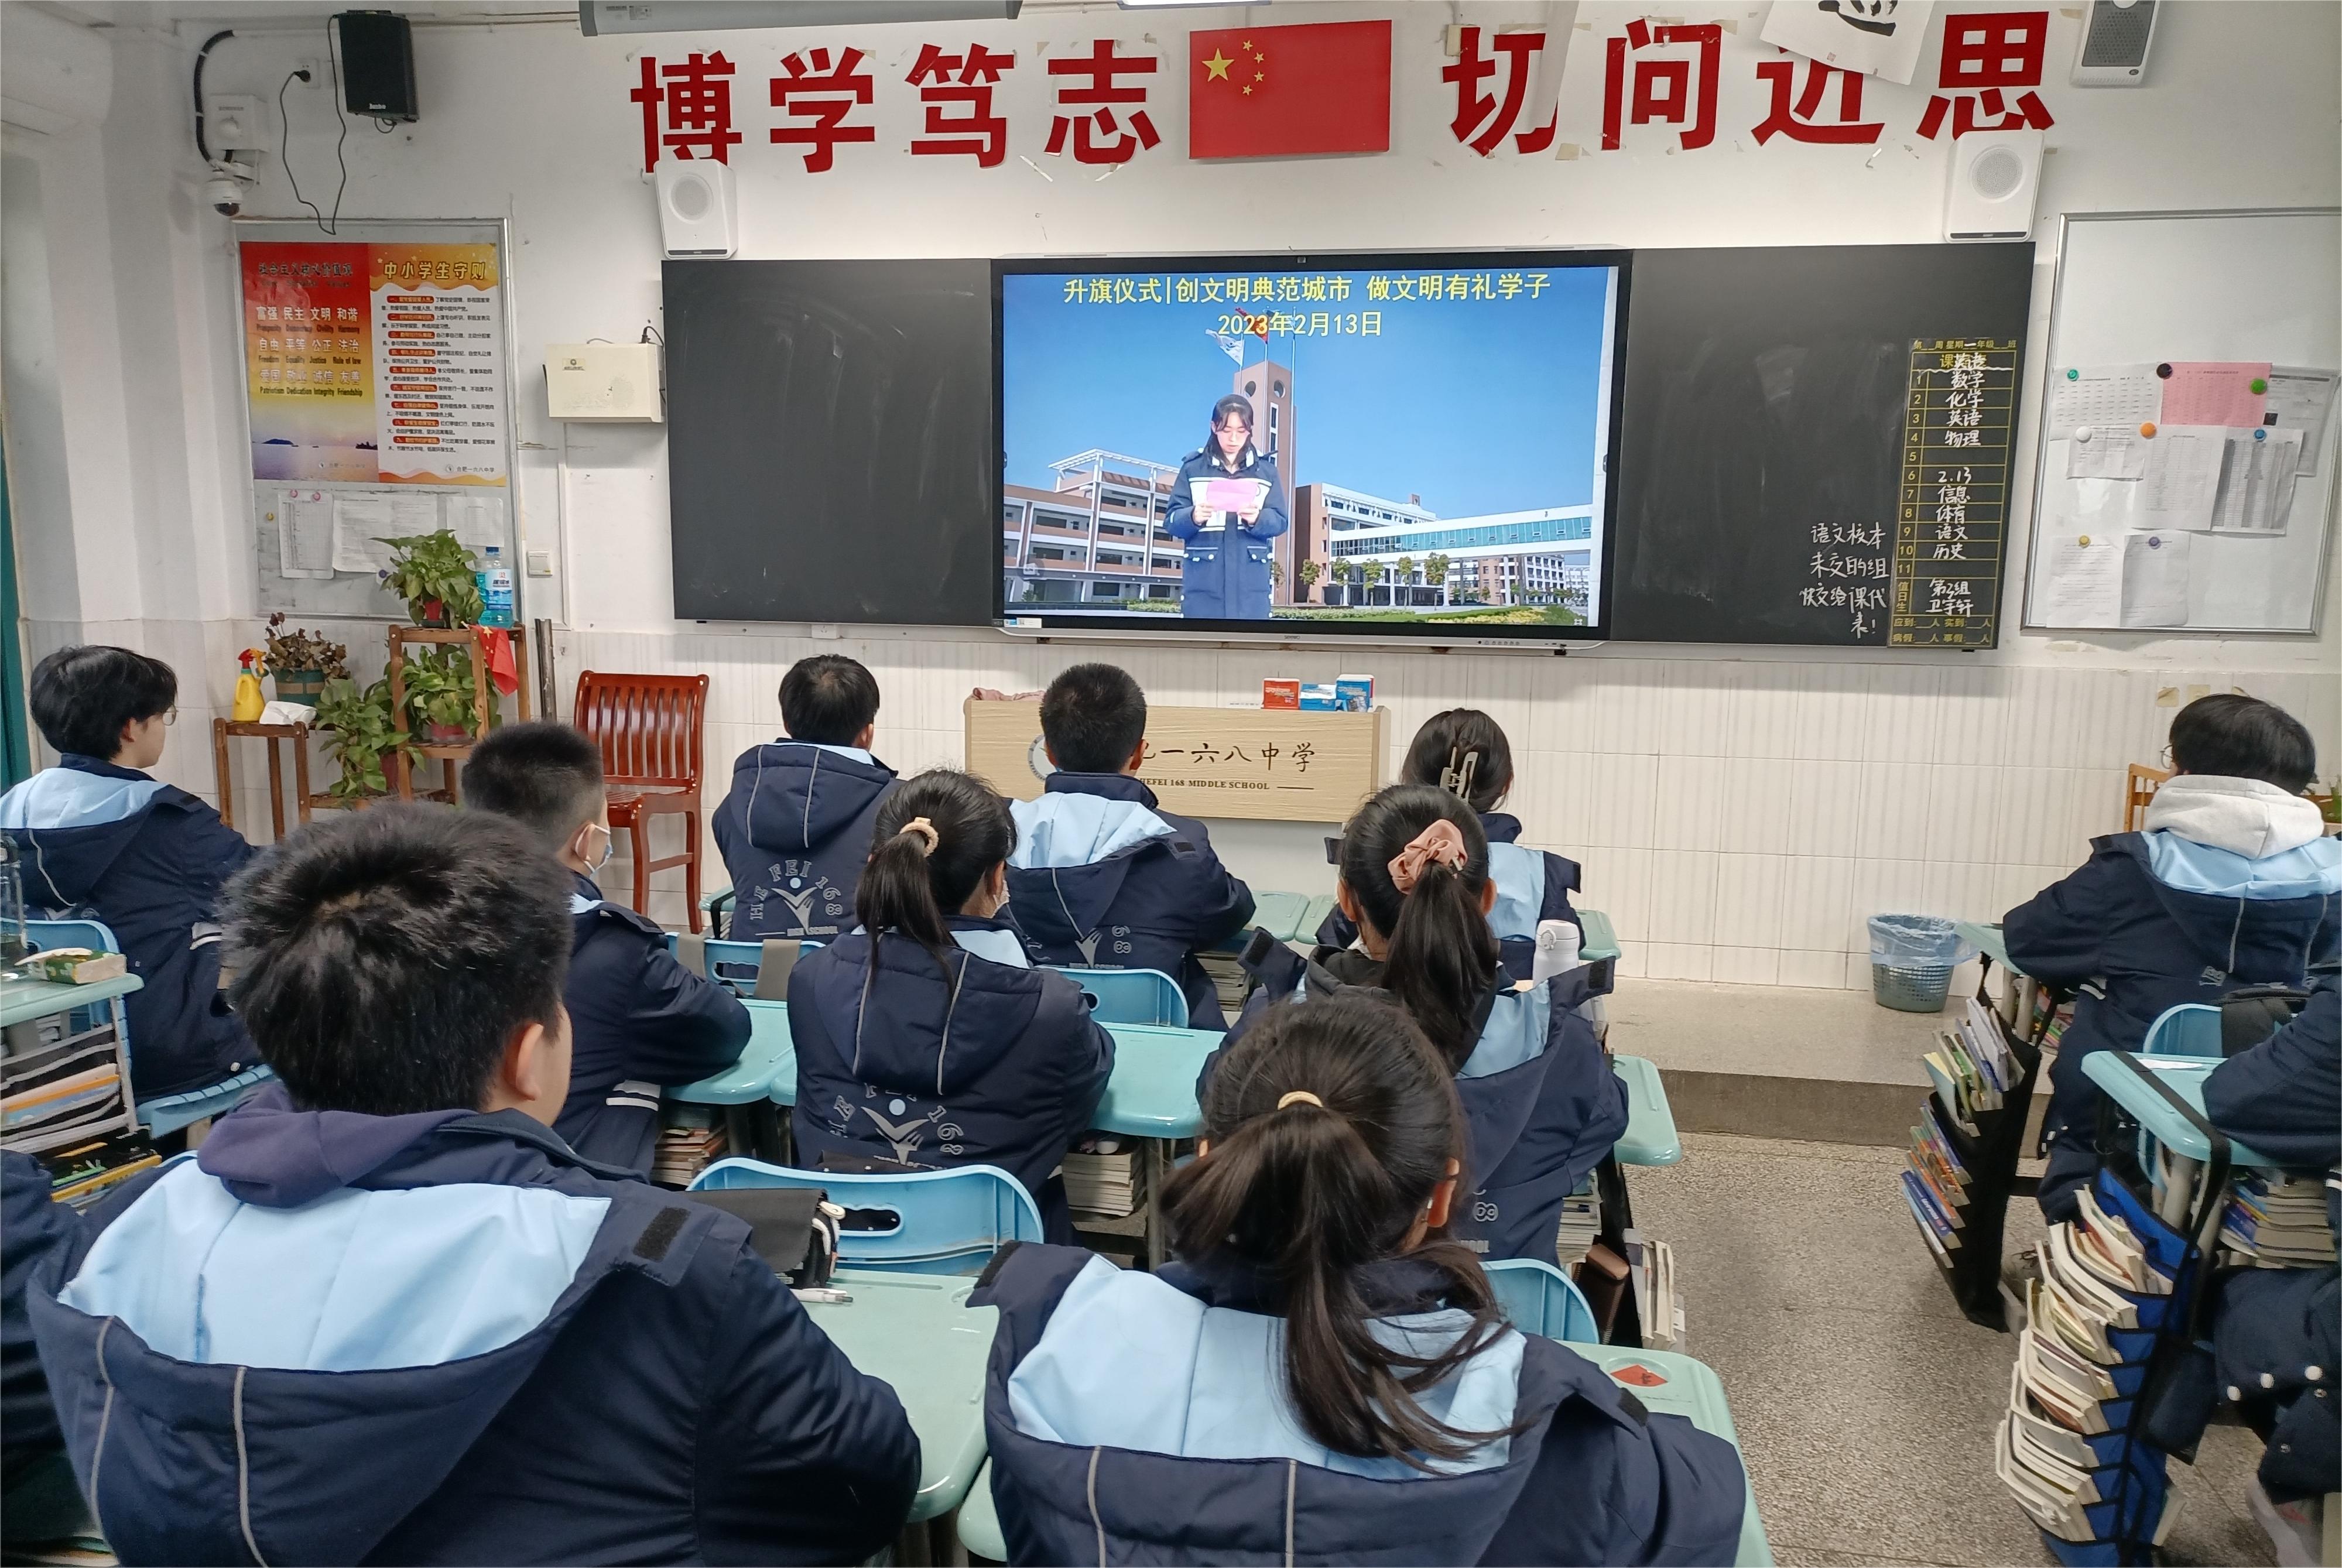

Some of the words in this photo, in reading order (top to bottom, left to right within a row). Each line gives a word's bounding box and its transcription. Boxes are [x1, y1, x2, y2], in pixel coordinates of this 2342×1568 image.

[631, 39, 1160, 174] 博学笃志
[384, 262, 485, 279] 中小学生守则
[1366, 273, 1550, 302] 做文明有礼学子
[256, 306, 278, 320] 富强
[283, 307, 304, 321] 民主
[310, 307, 331, 321] 文明
[337, 307, 358, 323] 和谐
[1217, 311, 1382, 338] 2023年2月13日
[259, 338, 279, 351] 自由
[286, 338, 306, 351] 平等
[312, 338, 333, 352] 公正
[338, 339, 359, 353] 法治
[260, 369, 280, 383] 爱国
[313, 370, 333, 385] 诚信
[340, 371, 360, 385] 友善
[1916, 375, 1922, 385] 1
[1951, 371, 1985, 389] 数学
[1914, 394, 1921, 405] 2
[1945, 389, 1984, 409] 化学
[1912, 414, 1920, 424] 3
[1946, 409, 1983, 427] 英语
[1910, 433, 1918, 443] 4
[1944, 429, 1981, 448] 物理
[1909, 451, 1916, 461] 5
[1908, 470, 1916, 480] 6
[1938, 467, 1971, 484] 2.13
[1906, 489, 1914, 499] 7
[1937, 484, 1971, 504] 信息
[1905, 508, 1913, 518] 8
[1936, 504, 1966, 524] 体育
[1810, 522, 1886, 550] 语文校本
[1903, 526, 1911, 536] 9
[1935, 523, 1968, 541] 语文
[1899, 545, 1913, 556] 10
[1933, 542, 1967, 560] 历史
[1810, 551, 1890, 579] 未交的组
[1898, 564, 1911, 574] 11
[1896, 581, 1910, 612] 值日生
[1170, 779, 1185, 787] 168
[1188, 779, 1227, 789] MIDDLE
[1229, 780, 1269, 790] SCHOOL
